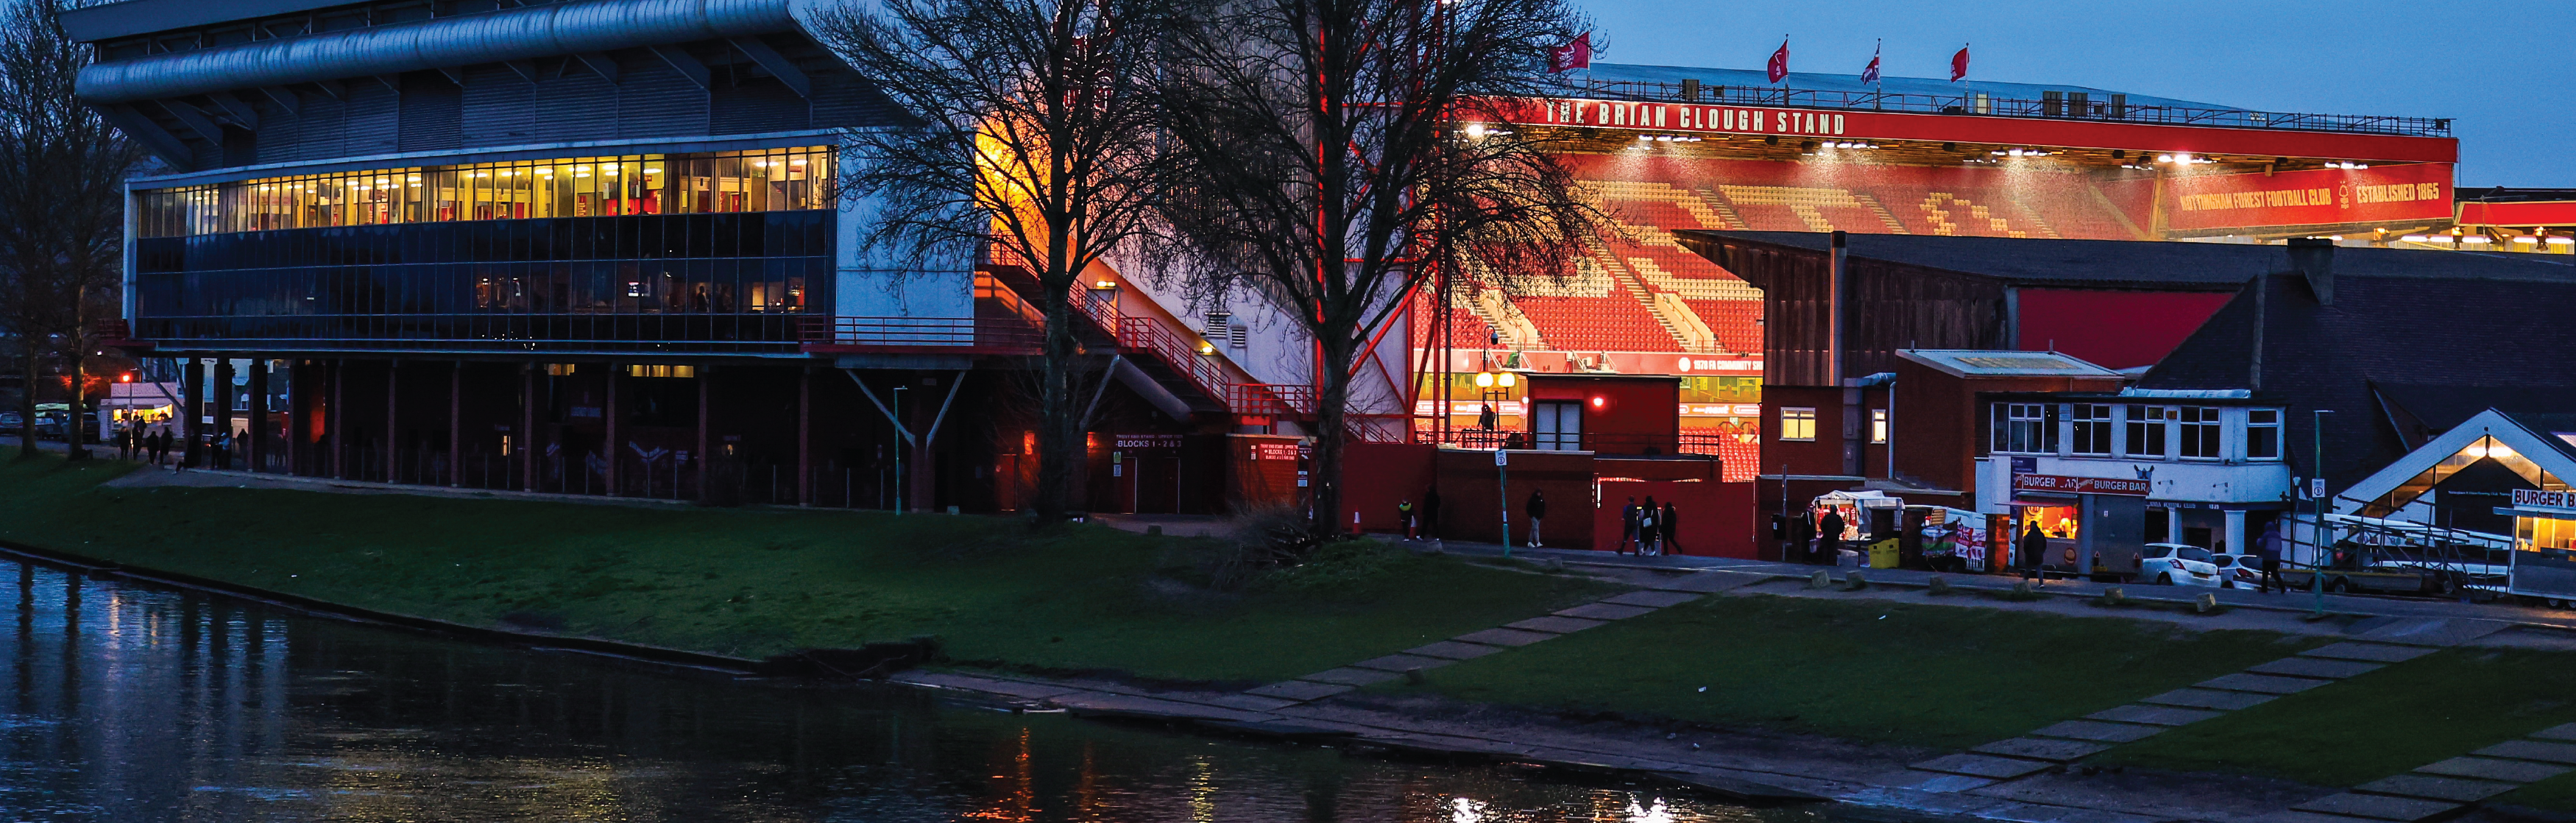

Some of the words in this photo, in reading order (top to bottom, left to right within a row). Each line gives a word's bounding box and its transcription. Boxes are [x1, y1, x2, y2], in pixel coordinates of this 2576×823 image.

[1546, 101, 1585, 124] THE
[1599, 103, 1666, 127] BRIAN
[1680, 107, 1763, 131] CLOUGH
[1777, 111, 1844, 135] STAND
[2180, 193, 2234, 211] NOTTINGHAM
[2233, 191, 2265, 209] FOREST
[2265, 188, 2308, 207] FOOTBALL
[2308, 188, 2332, 206] CLUB
[2356, 183, 2416, 203] ESTABLISHED
[2416, 182, 2439, 201] 1865
[1694, 359, 1708, 370] 1978
[1708, 360, 1716, 370] FA
[1717, 360, 1751, 370] COMMUNITY
[2024, 476, 2056, 487] BURGER
[2094, 480, 2127, 490] BURGER
[2129, 482, 2146, 491] BAR
[2515, 490, 2563, 506] BURGER
[2568, 493, 2575, 508] B
